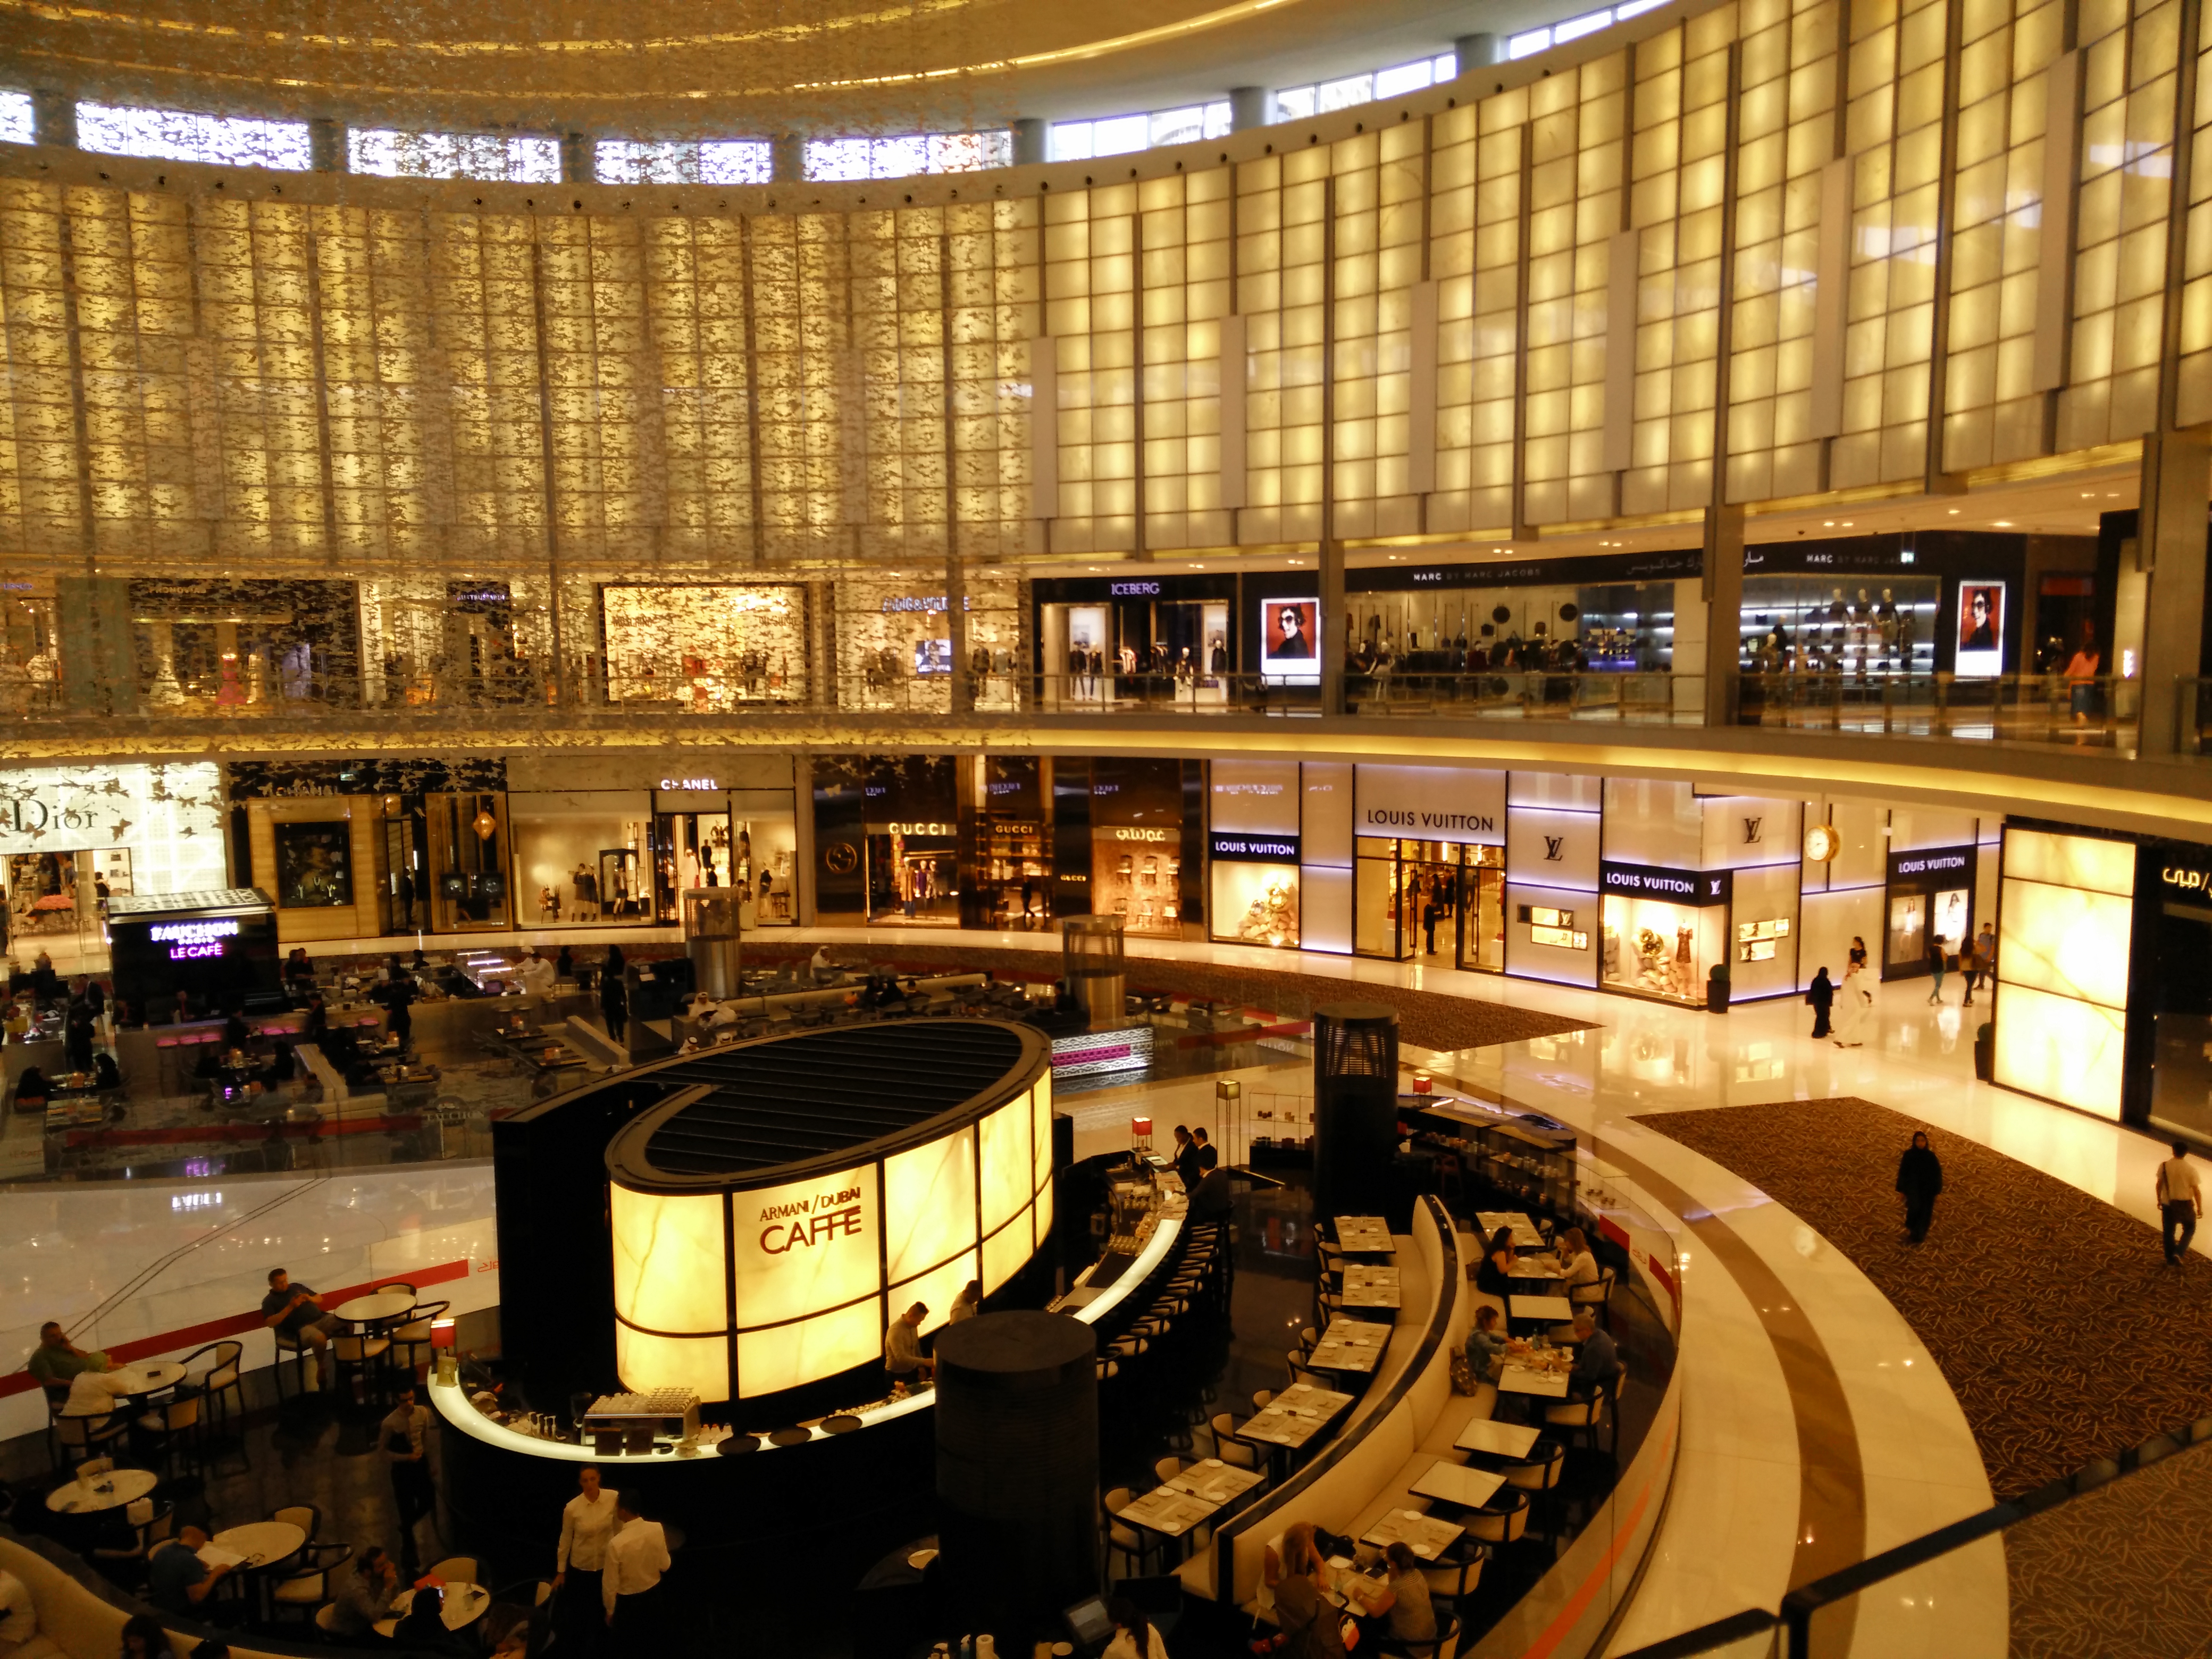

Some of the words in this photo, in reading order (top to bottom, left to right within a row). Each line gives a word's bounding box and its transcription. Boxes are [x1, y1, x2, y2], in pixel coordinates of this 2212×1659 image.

[1806, 555, 1833, 564] MARC
[1413, 572, 1442, 581] MARC
[1464, 570, 1492, 579] MARC
[1497, 568, 1541, 578] JACOBS
[1111, 582, 1160, 595] ICEBERG
[660, 778, 718, 790] CHANEL
[9, 798, 98, 833] Dior
[1368, 809, 1415, 826] LOUIS
[1421, 812, 1493, 832] VUITTON
[889, 822, 947, 836] GUCCI
[995, 825, 1034, 834] GUCCI
[1215, 841, 1247, 853] LOUIS
[1249, 842, 1295, 855] VUITTON
[1898, 860, 1925, 873] LOUIS
[1926, 856, 1965, 870] VUITTON
[1606, 873, 1640, 886] LOUIS
[1643, 876, 1695, 894] VUITTON
[150, 921, 238, 942] FAUCHON
[170, 948, 186, 959] LE
[187, 942, 223, 957] CAFÉ
